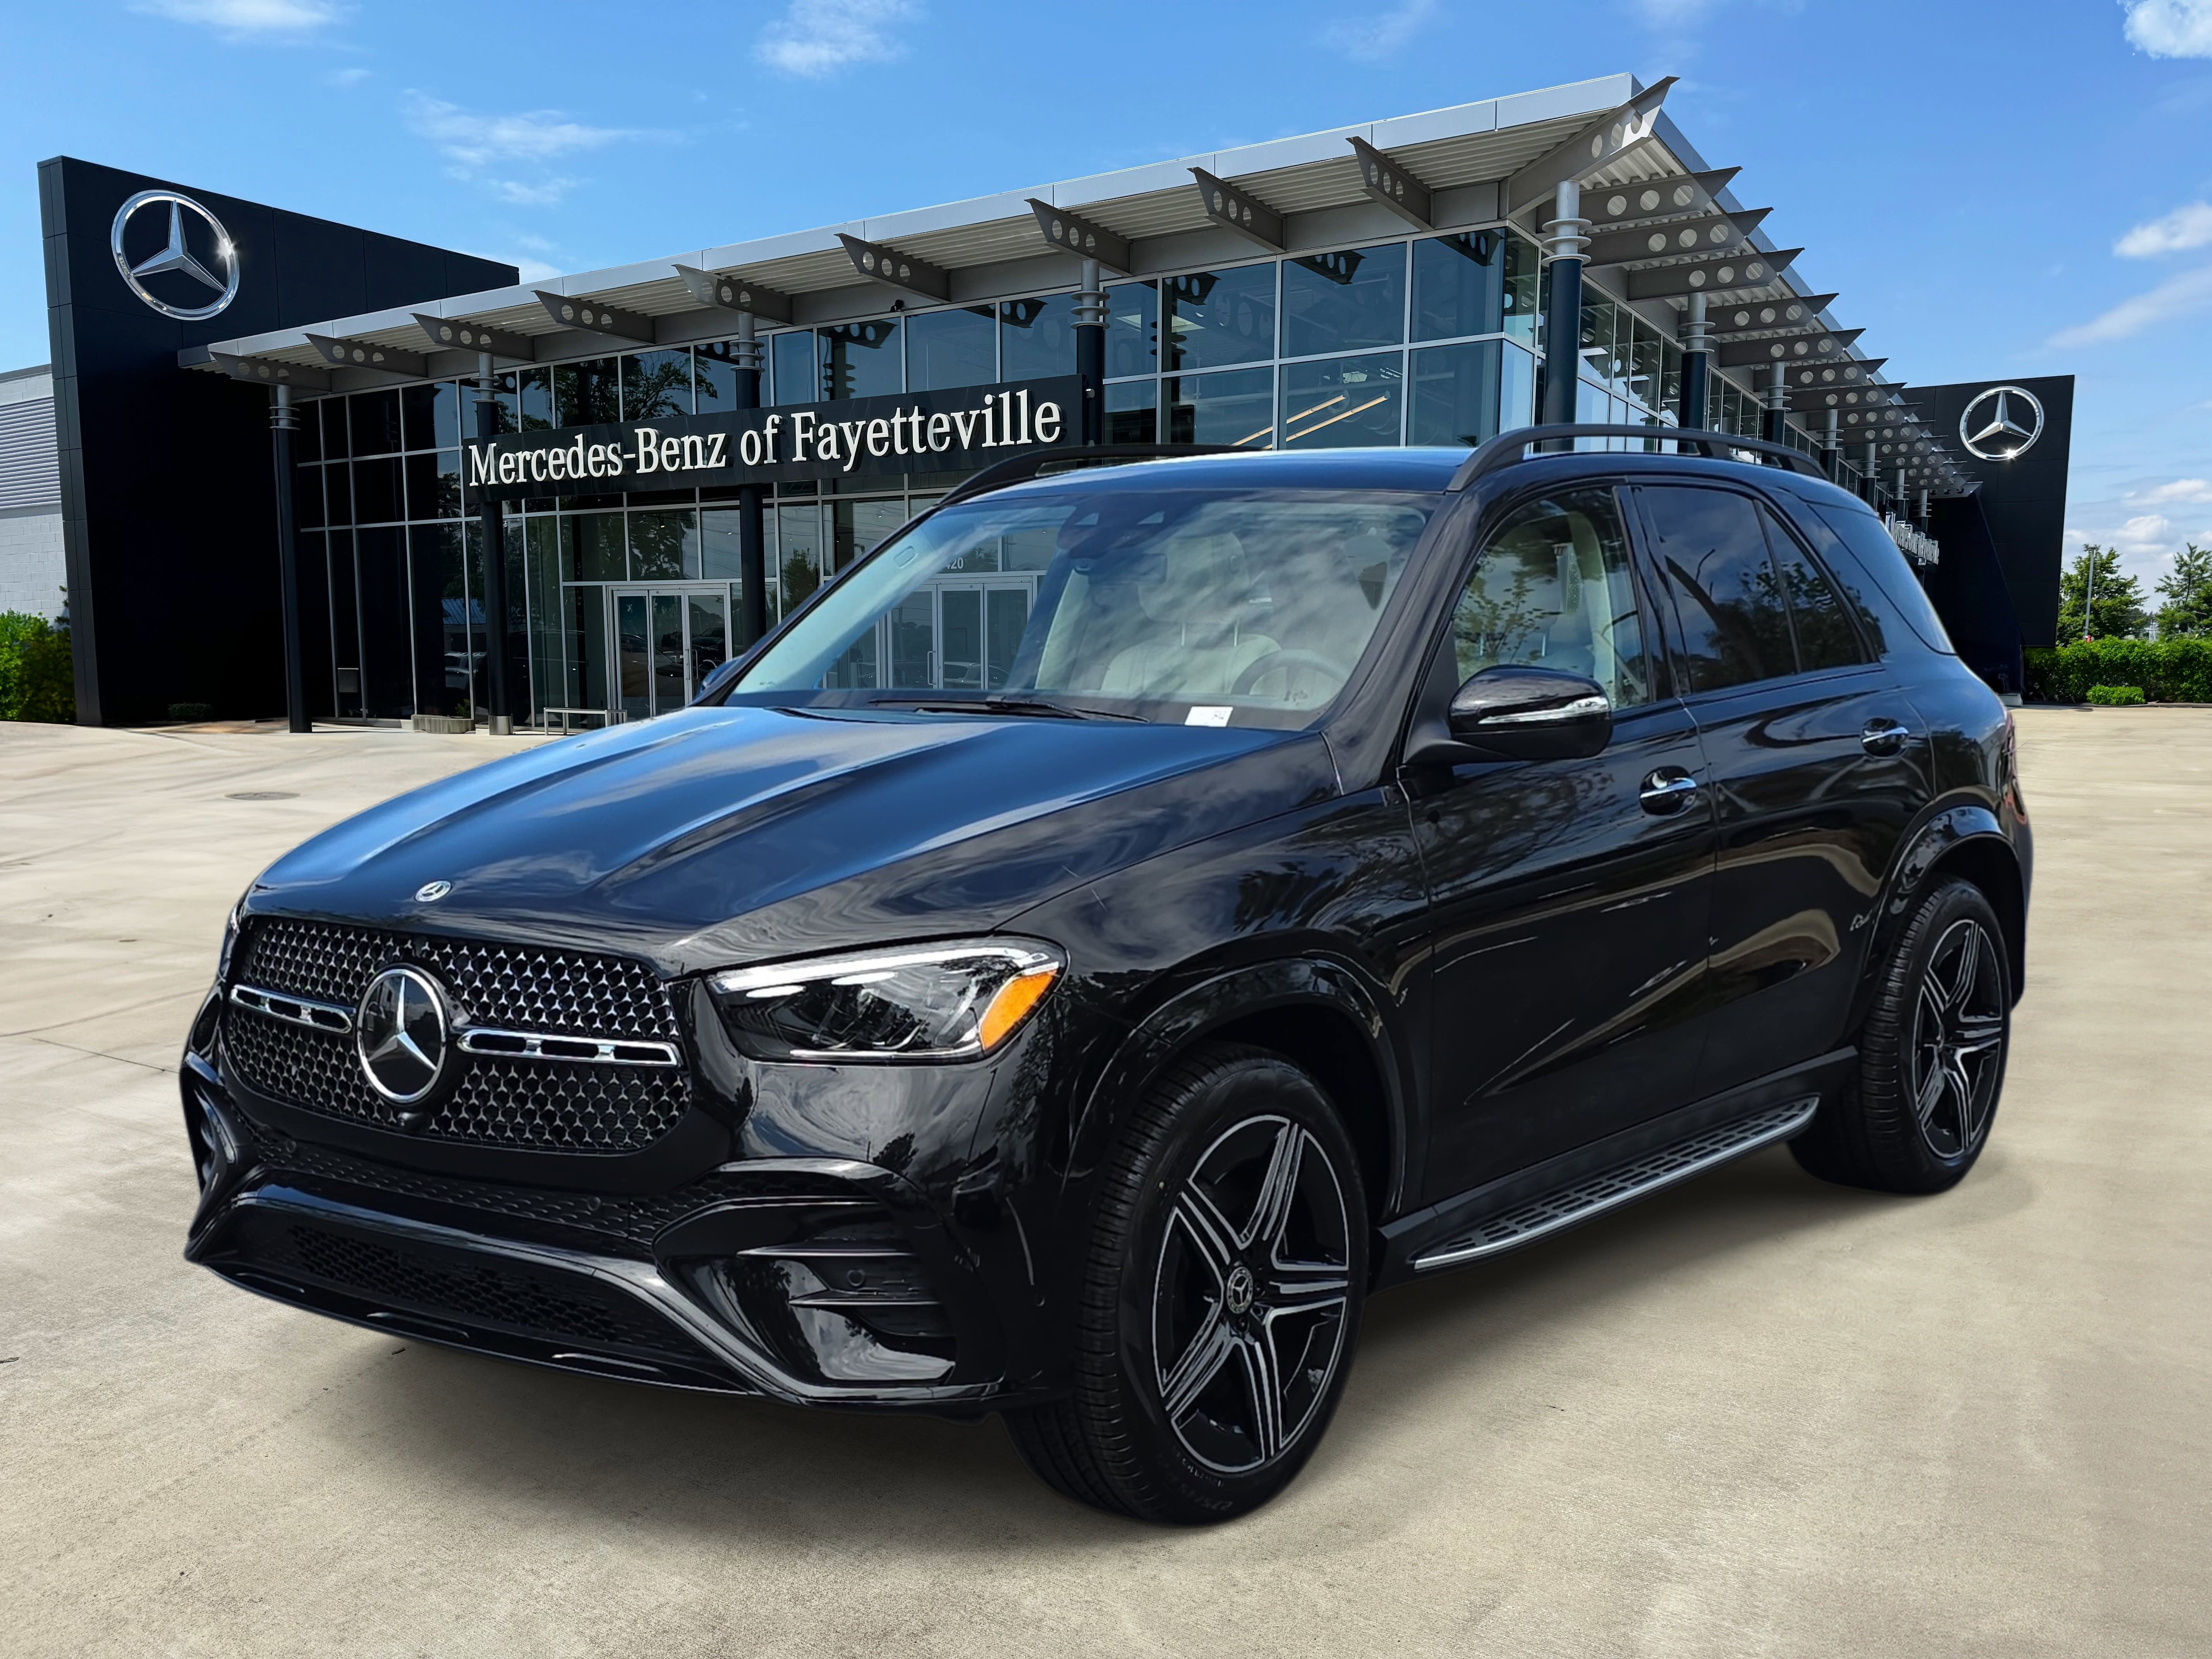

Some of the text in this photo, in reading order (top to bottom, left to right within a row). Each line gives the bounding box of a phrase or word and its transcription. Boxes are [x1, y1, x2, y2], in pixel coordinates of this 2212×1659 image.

[468, 388, 1061, 487] Mercedes-Benz of Fayetteville
